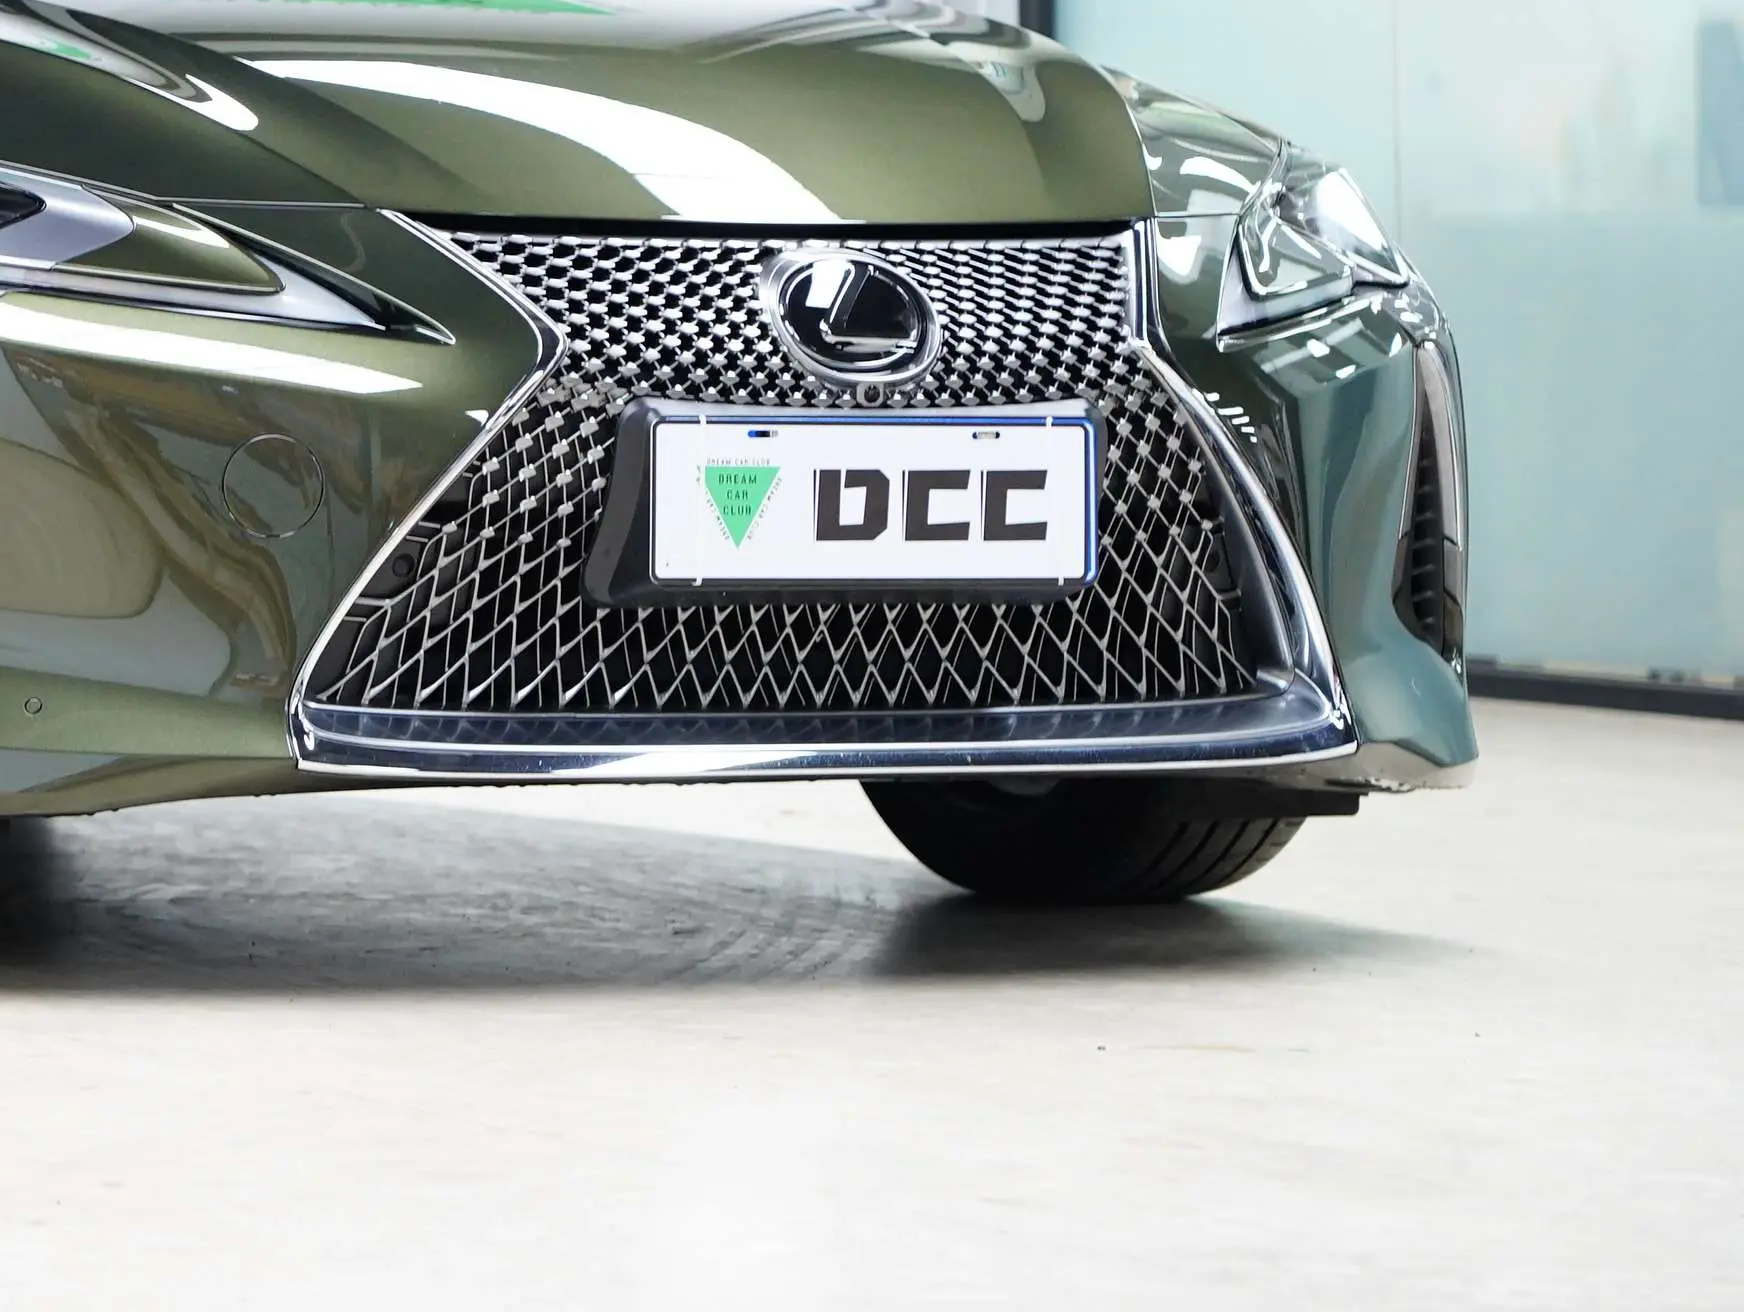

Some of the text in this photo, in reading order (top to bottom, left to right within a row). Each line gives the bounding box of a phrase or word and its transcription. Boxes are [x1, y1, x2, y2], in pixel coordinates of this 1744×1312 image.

[718, 473, 757, 484] DREAM
[727, 489, 749, 500] CAR
[813, 468, 1048, 542] DCC
